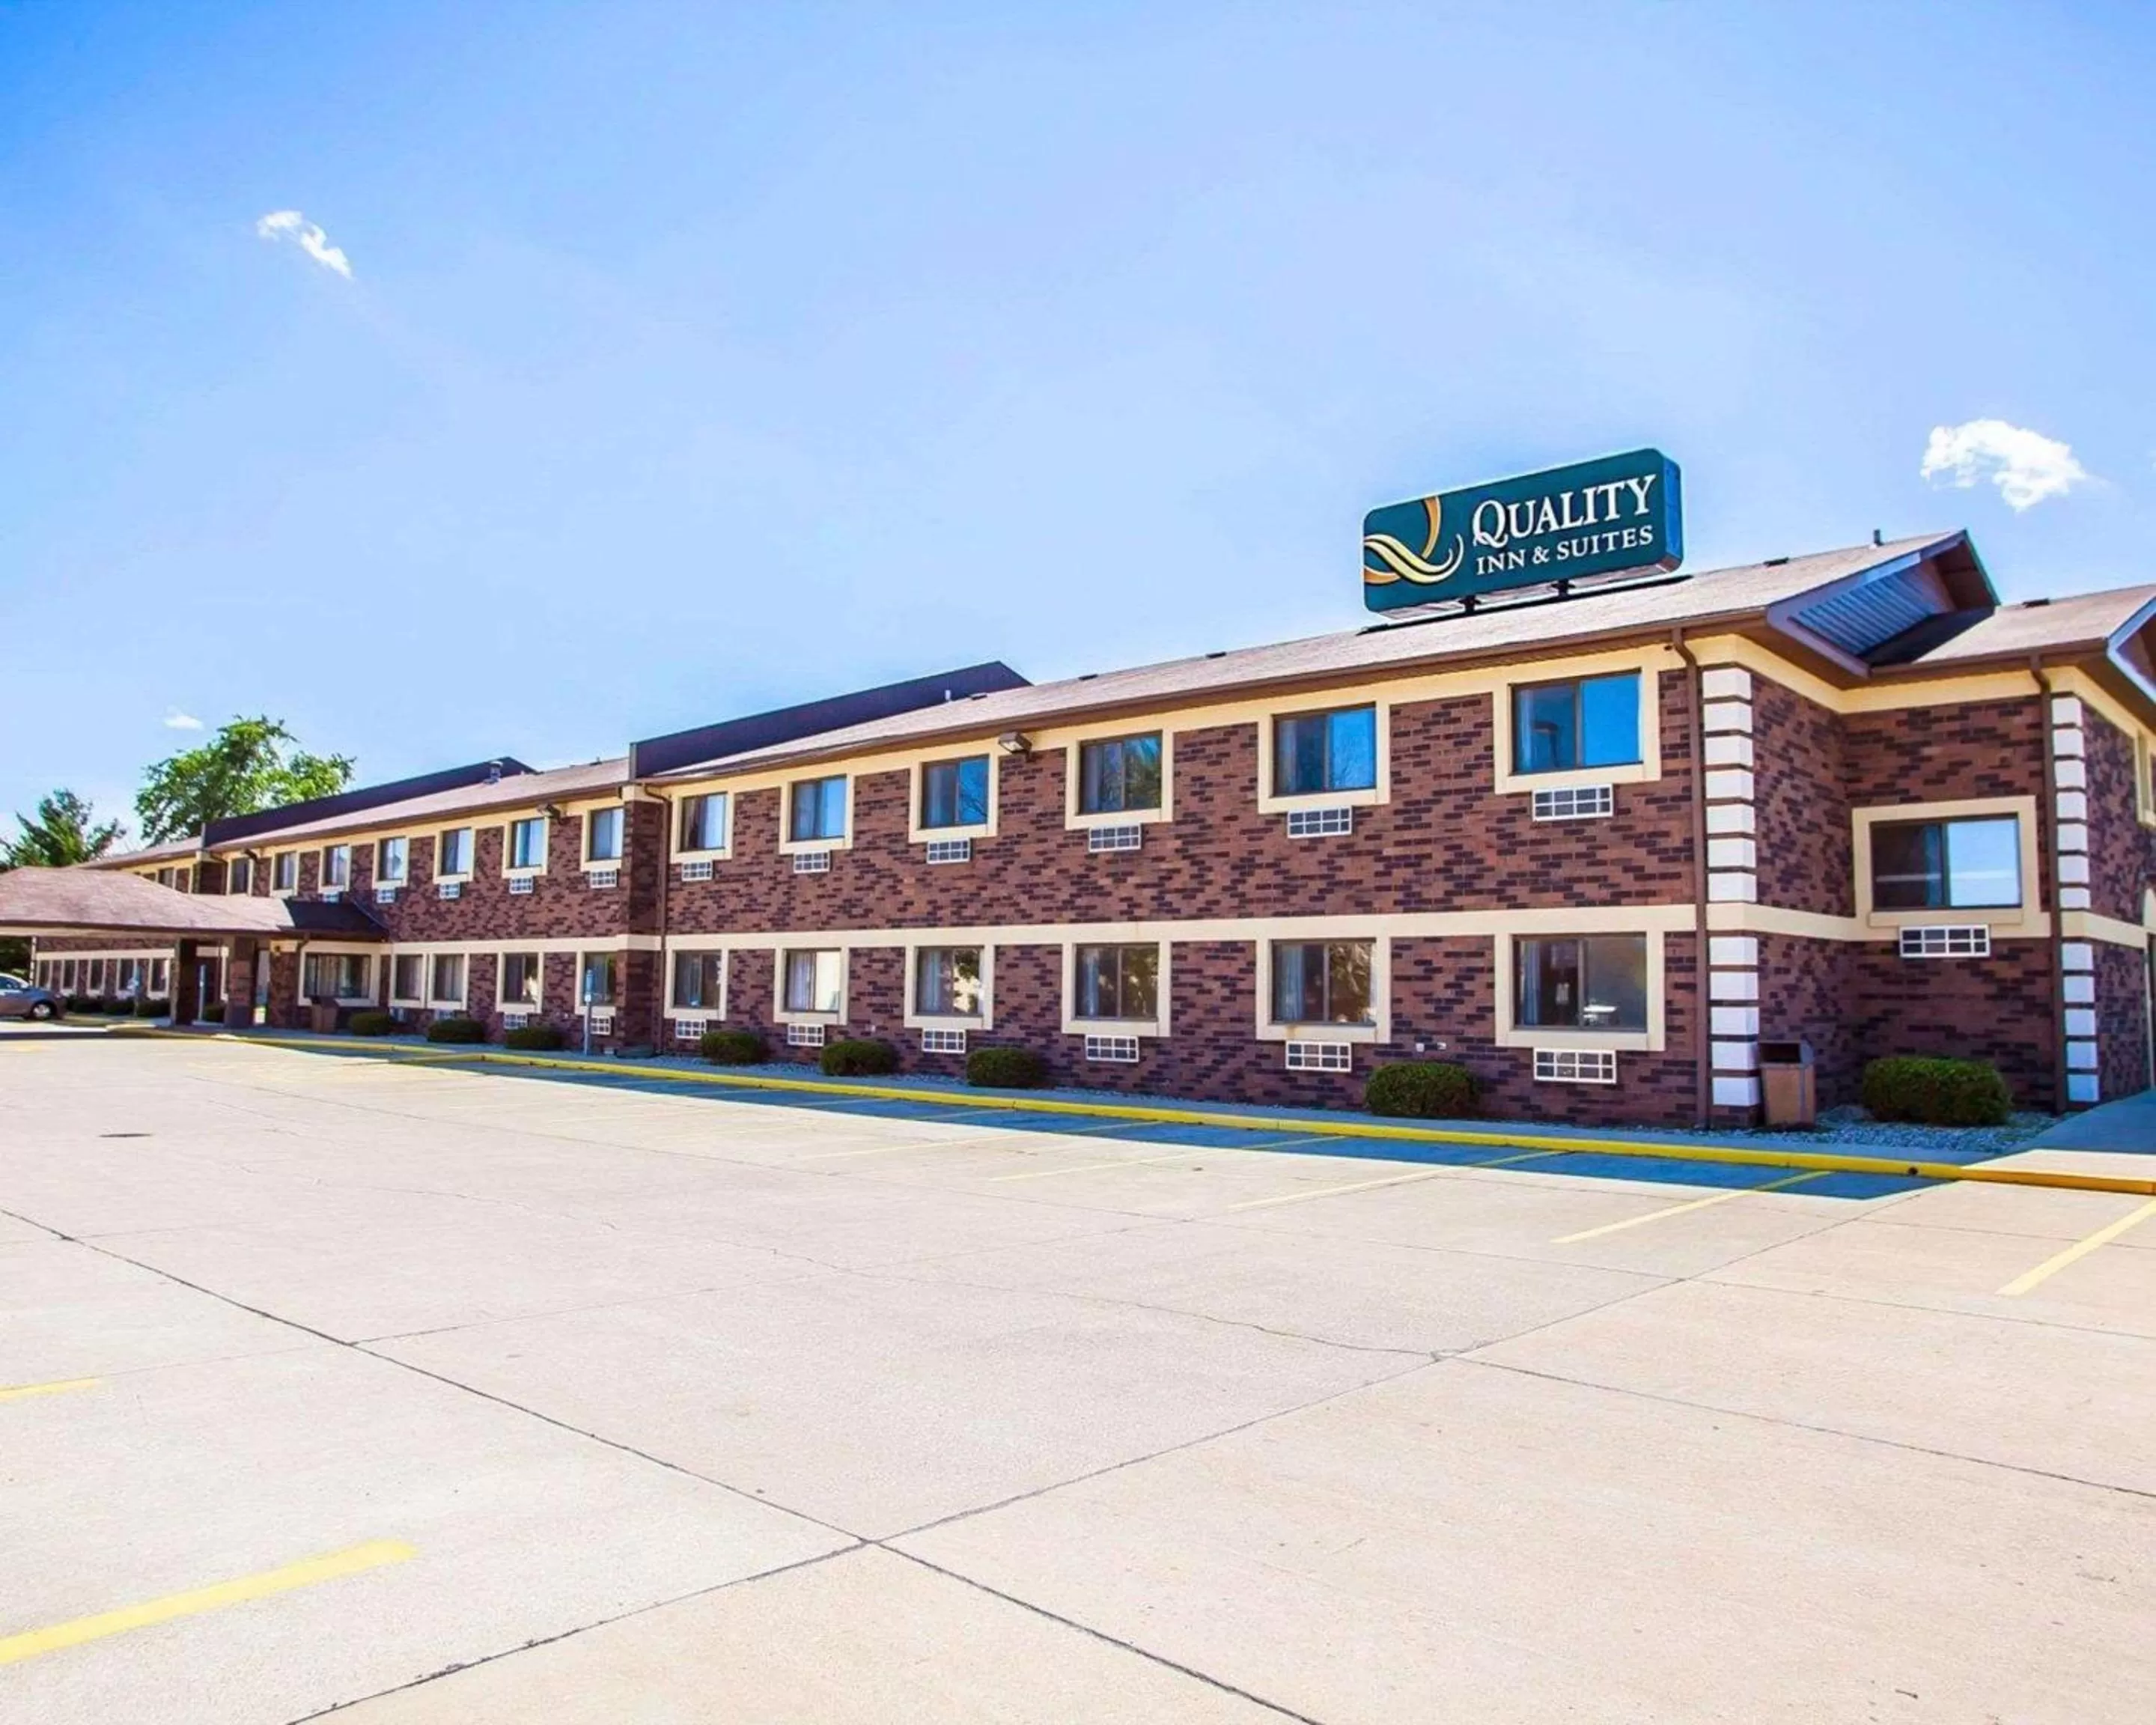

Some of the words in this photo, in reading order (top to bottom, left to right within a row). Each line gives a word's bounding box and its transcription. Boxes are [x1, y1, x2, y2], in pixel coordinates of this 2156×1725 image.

[1472, 474, 1657, 548] QUALITY
[1476, 549, 1526, 575] INN
[1532, 546, 1550, 565] &
[1556, 525, 1654, 561] SUITES
